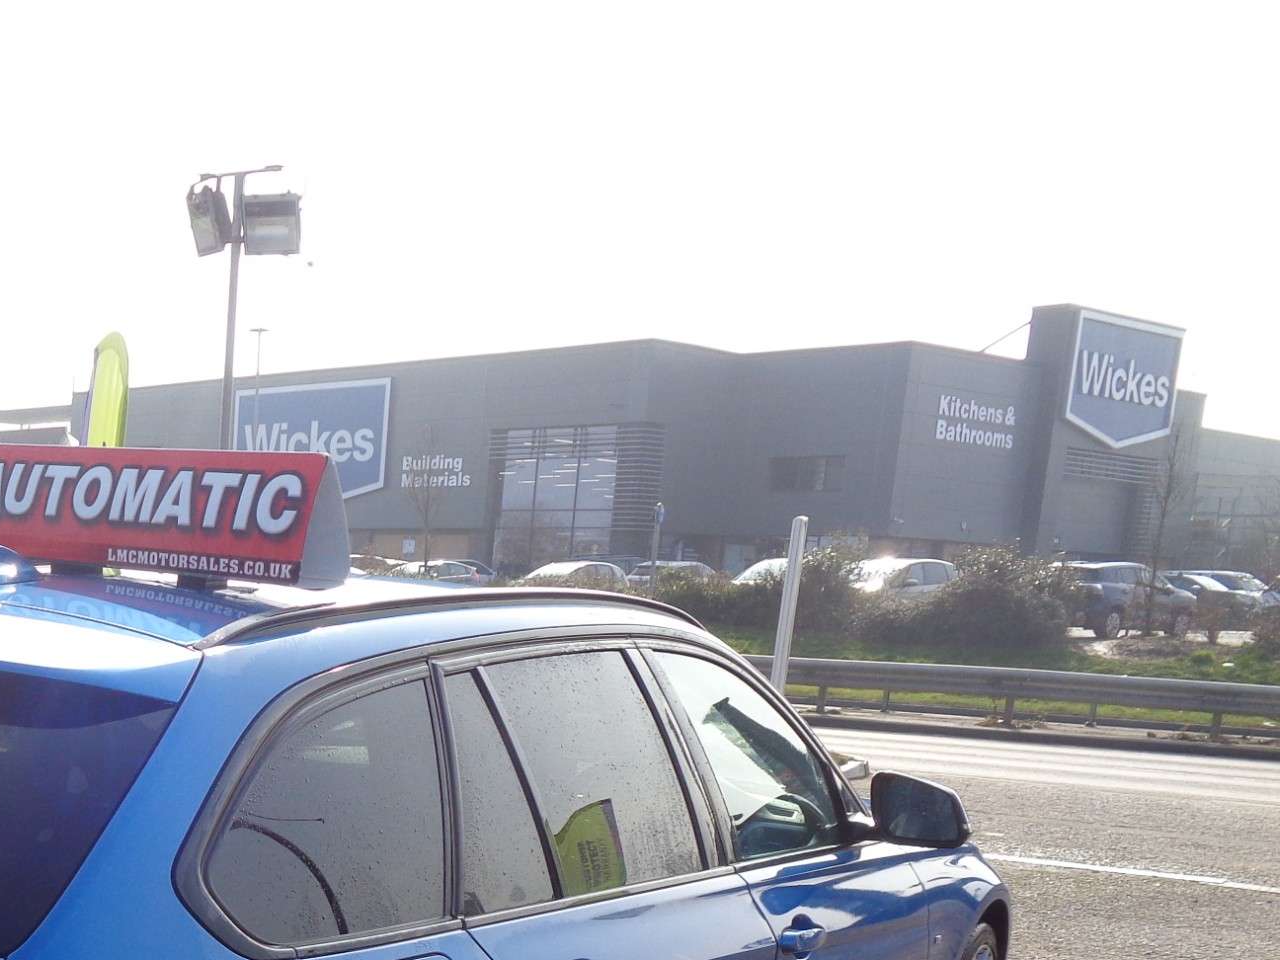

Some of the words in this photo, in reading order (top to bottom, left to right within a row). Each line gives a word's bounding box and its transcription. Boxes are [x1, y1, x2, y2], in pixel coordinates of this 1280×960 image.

[1081, 349, 1170, 408] Wickes
[939, 394, 1003, 424] Kitchens
[1004, 406, 1016, 426] &
[244, 420, 375, 463] Wickes
[935, 419, 1014, 449] Bathrooms
[402, 454, 463, 472] Building
[400, 471, 471, 488] Materials
[107, 547, 294, 580] LMCMOTORSALES.CO.UK
